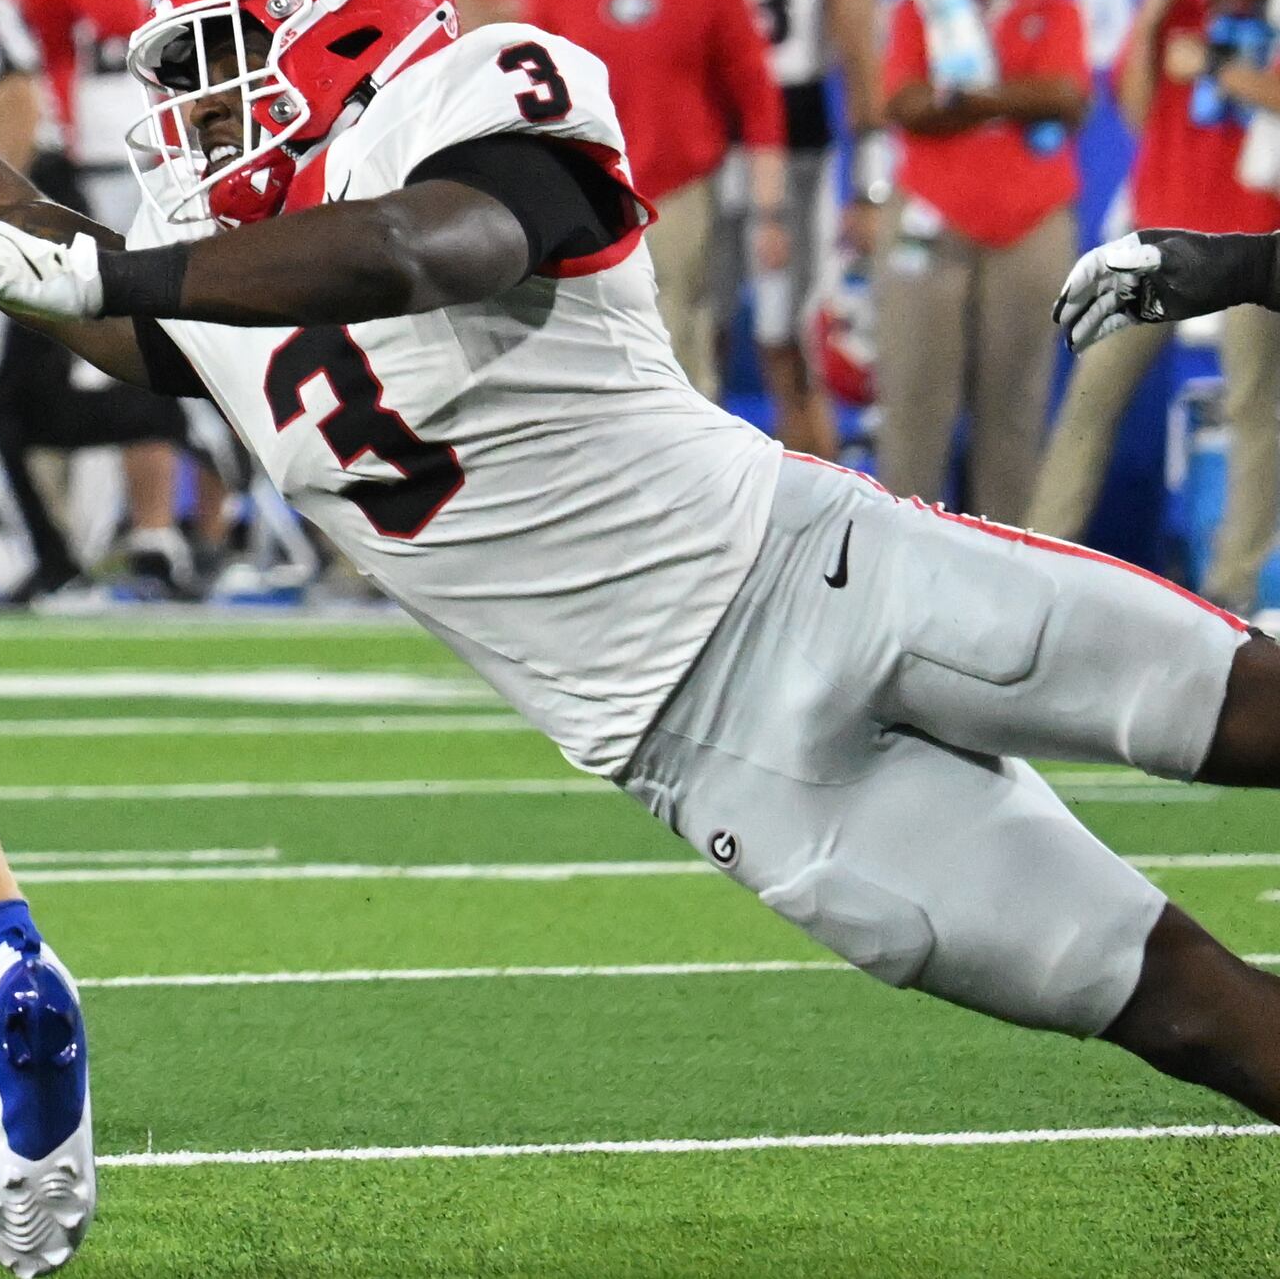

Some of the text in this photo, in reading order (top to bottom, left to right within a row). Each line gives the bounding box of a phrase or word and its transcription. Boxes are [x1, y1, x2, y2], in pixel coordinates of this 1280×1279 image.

[497, 41, 572, 123] 3
[263, 323, 466, 541] 3
[711, 832, 736, 863] G
